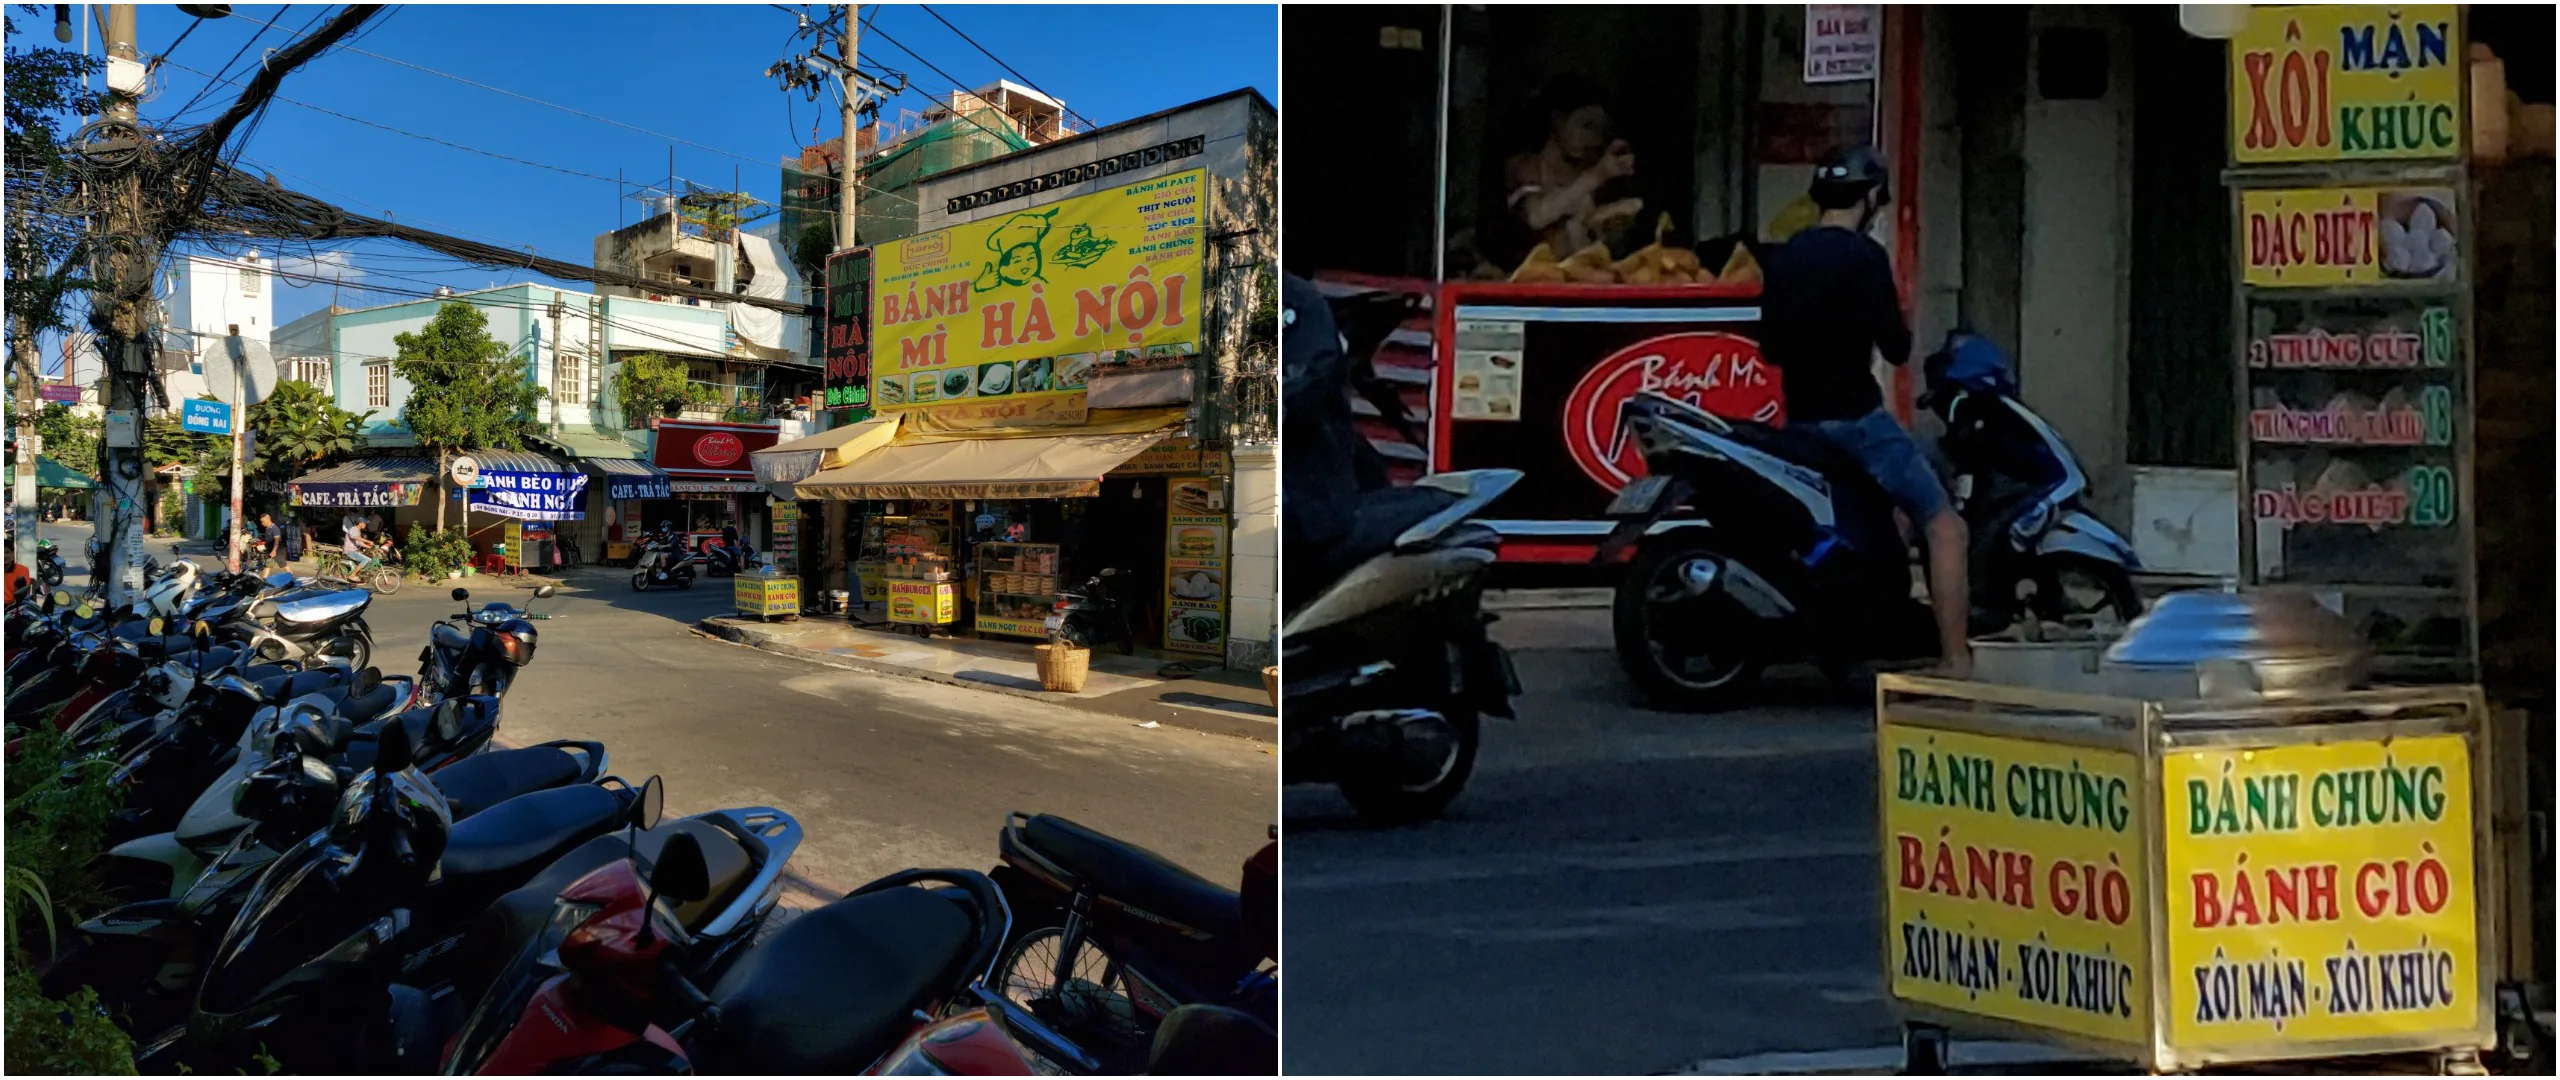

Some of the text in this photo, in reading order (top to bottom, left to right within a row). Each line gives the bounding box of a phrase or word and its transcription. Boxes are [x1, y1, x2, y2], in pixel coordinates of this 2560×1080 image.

[2340, 9, 2449, 79] MẶN
[2243, 18, 2332, 149] XÔI
[2340, 89, 2454, 151] KHÚC
[1126, 184, 1153, 197] BÁNH
[1170, 175, 1197, 187] PATE
[1137, 195, 1196, 213] THỊT NGUỘI
[1128, 244, 1157, 255] BÁNH
[2250, 193, 2375, 279] ĐẶC BIỆT
[829, 255, 869, 288] BÁNH
[834, 284, 863, 318] MÌ
[881, 280, 971, 326] BÁNH
[981, 265, 1187, 350] HÀ NỘI
[831, 315, 864, 349] HÀ
[900, 322, 948, 369] MÌ
[2271, 328, 2362, 367] TRỨNG
[2422, 308, 2450, 367] 15
[827, 347, 867, 384] NỘI
[212, 417, 228, 429] NAI
[979, 400, 1027, 419] NỘI
[2423, 386, 2451, 445] 18
[302, 484, 388, 506] CAFE TRÀ TẮC
[486, 472, 517, 489] ÁNH
[521, 474, 552, 490] BÈO
[611, 477, 670, 499] CAFE TRÀ TẮC
[2410, 466, 2453, 525] 20
[892, 583, 933, 596] HAMBURGER
[978, 620, 997, 629] BÁNH
[998, 622, 1017, 632] NGỌT
[1898, 735, 2129, 833] BÁNH CHƯNG
[2187, 753, 2447, 835] BÁNH CHƯNG
[1898, 825, 2131, 925] BÁNH GIÒ
[2190, 840, 2449, 929] BÁNH GIÒ
[1123, 905, 1161, 924] HONDA
[1902, 908, 2132, 1018] XÔI MẶN XÔI KHÚC
[2194, 933, 2455, 1032] XÔI MẶN XÔI KHÚC
[541, 1003, 569, 1035] HONDA
